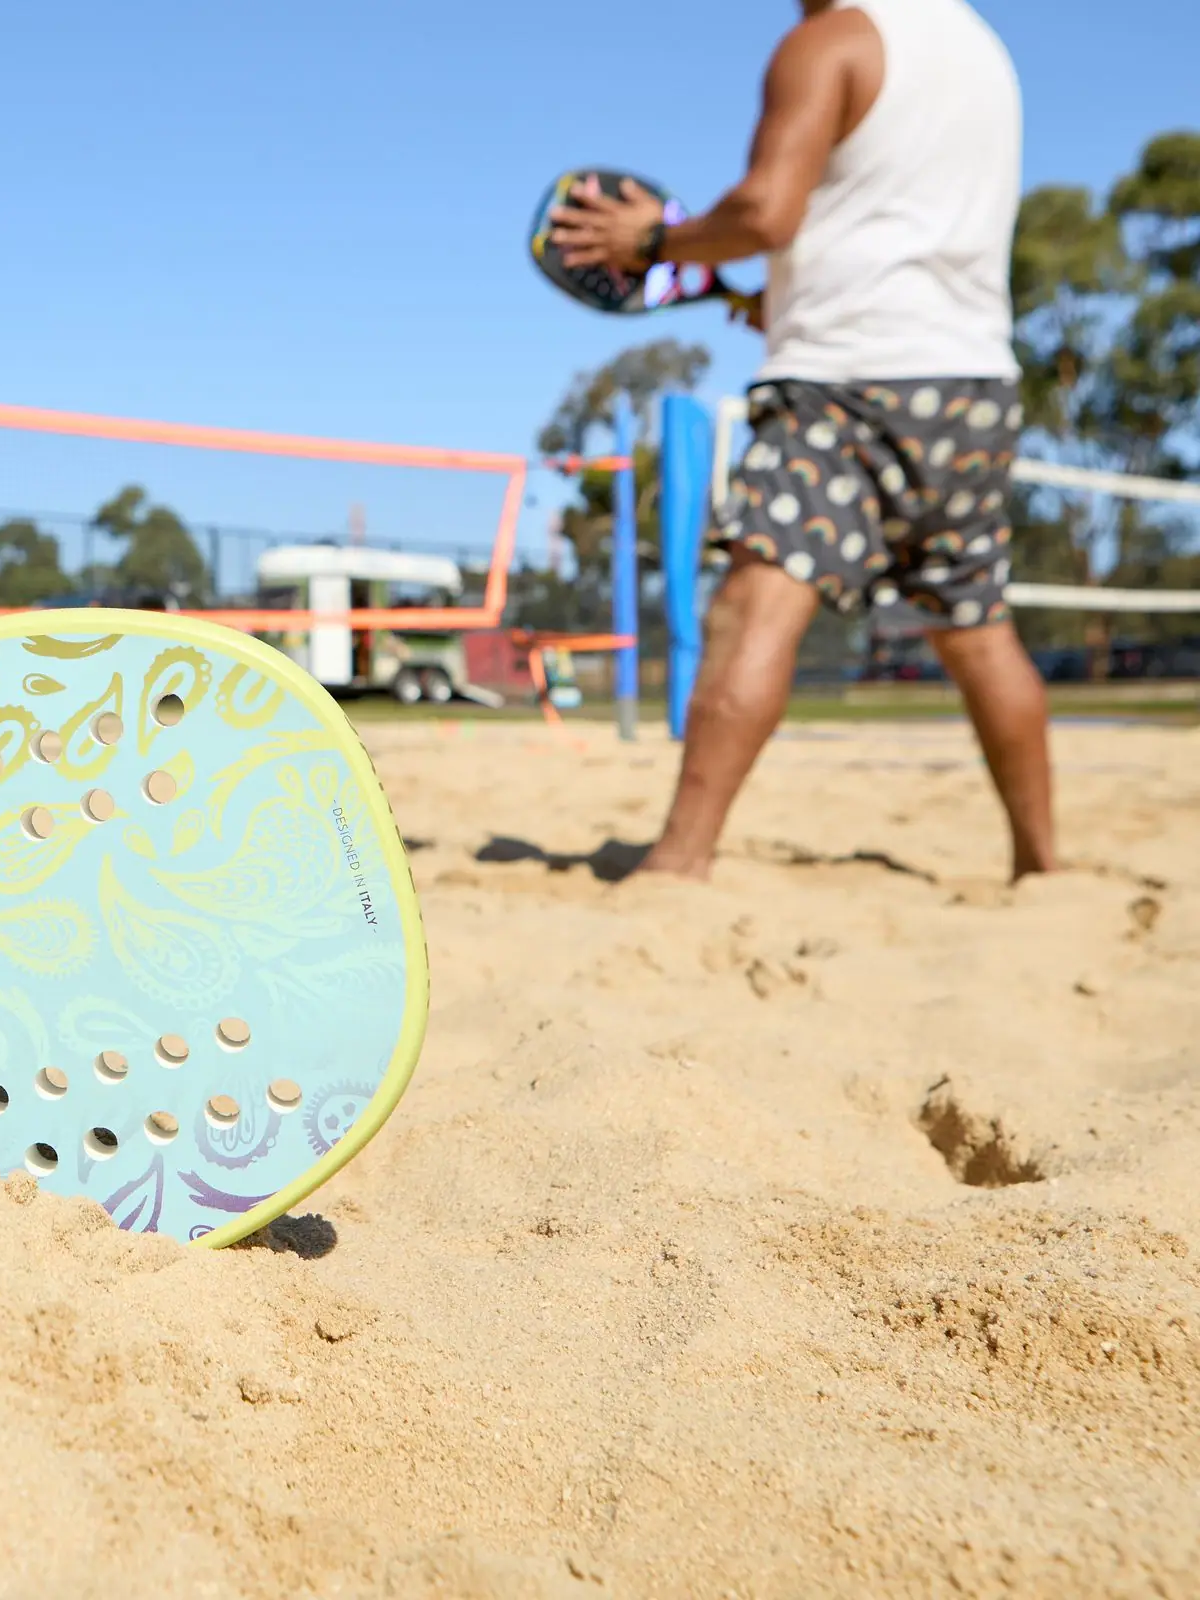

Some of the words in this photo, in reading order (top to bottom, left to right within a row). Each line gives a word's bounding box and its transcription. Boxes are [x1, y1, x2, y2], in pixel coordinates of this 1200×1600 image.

[332, 807, 361, 871] DESIGNED
[353, 873, 366, 888] IN
[359, 891, 378, 925] ITALY
